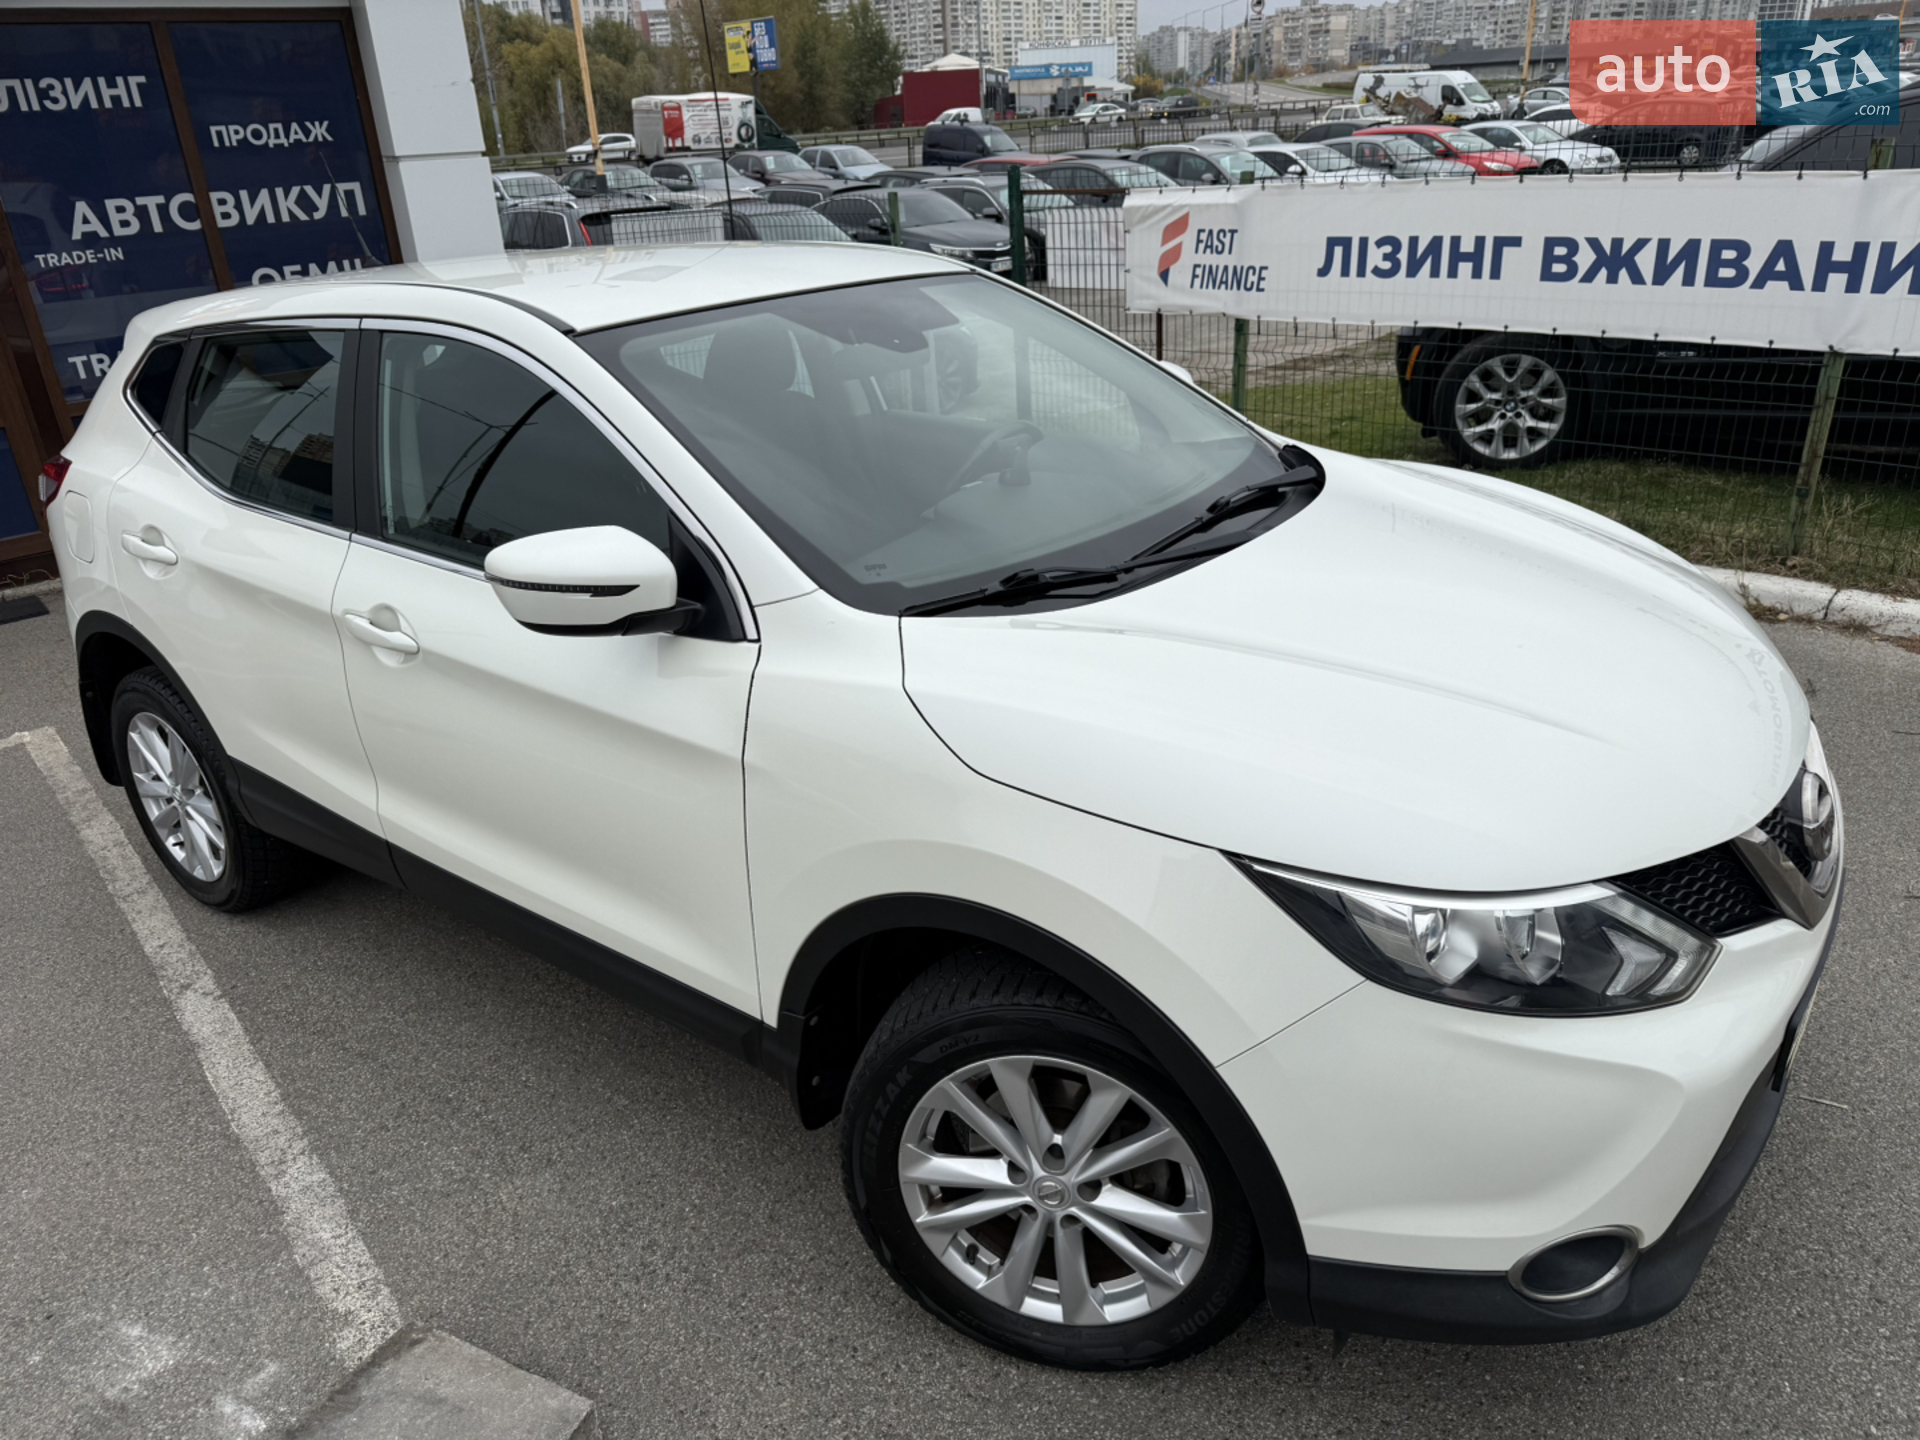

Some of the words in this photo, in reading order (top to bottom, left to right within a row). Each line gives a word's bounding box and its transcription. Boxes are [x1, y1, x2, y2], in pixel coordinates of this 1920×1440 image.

[0, 75, 147, 112] ЛІЗИНГ
[209, 120, 334, 148] ПРОДАЖ
[1194, 228, 1239, 256] FAST
[34, 247, 125, 269] TRADE-IN
[1316, 235, 1523, 280] ЛІЗИНГ
[1539, 236, 1920, 295] ВЖИВАНИ
[1190, 263, 1269, 293] FINANCE
[939, 1034, 980, 1054] DM-V2
